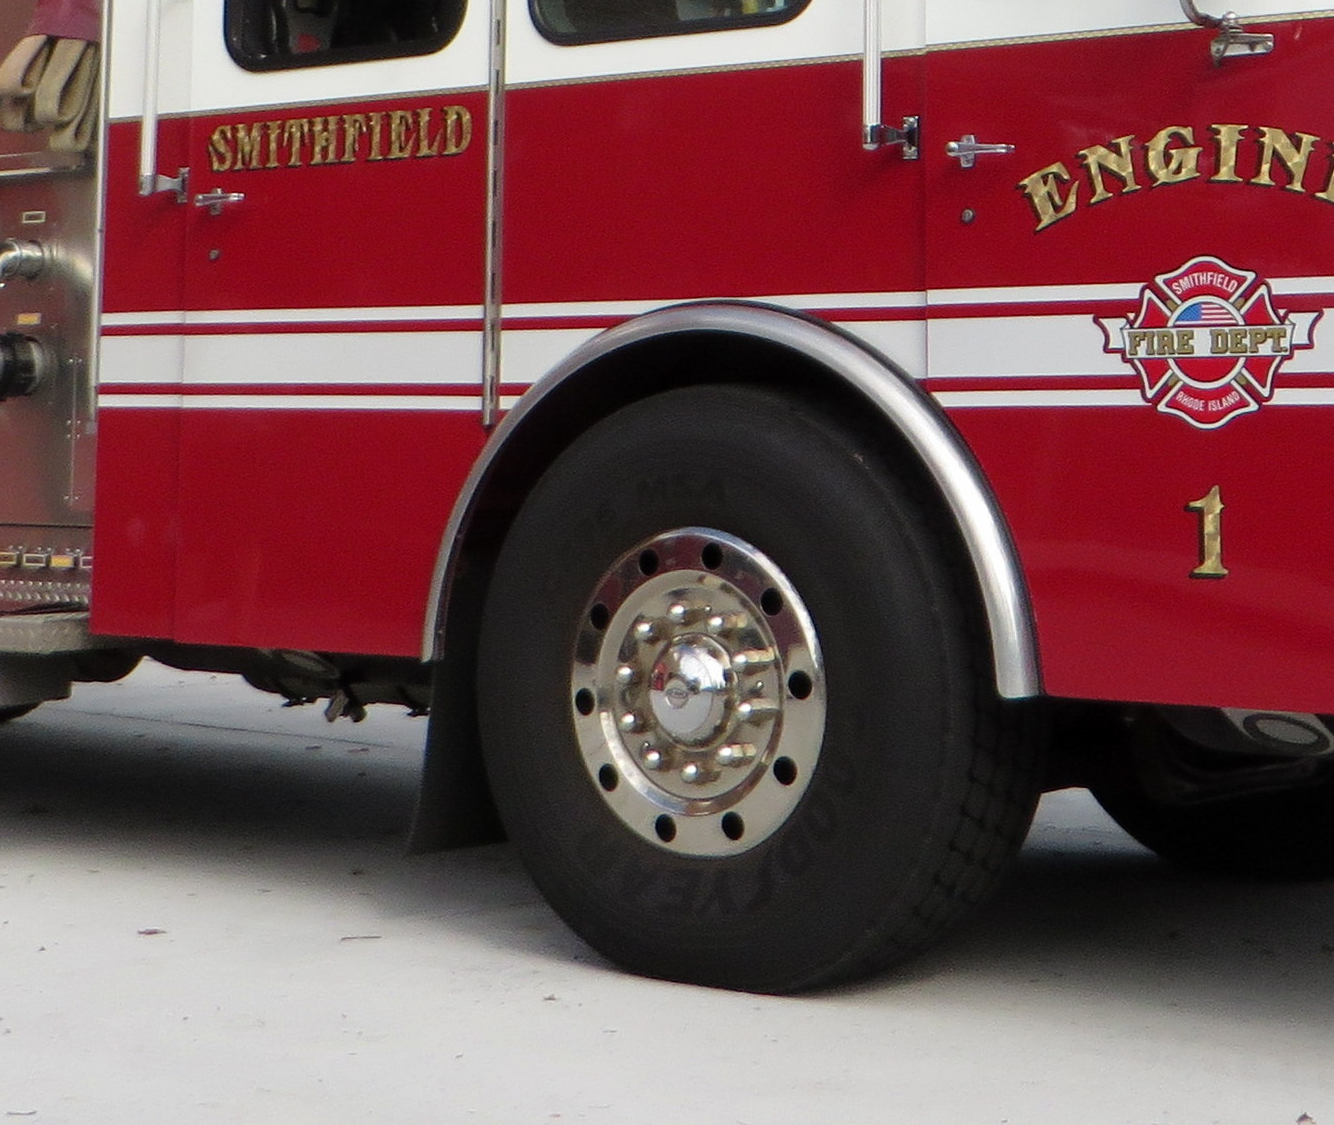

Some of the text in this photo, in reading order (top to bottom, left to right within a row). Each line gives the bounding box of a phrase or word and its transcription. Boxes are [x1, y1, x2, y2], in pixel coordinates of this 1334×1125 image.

[208, 105, 473, 173] SMITHFIELD
[1171, 271, 1240, 295] SMITHFIELD
[1127, 327, 1289, 355] FIRE DEPT.
[1174, 390, 1241, 412] RHODE ISLAND
[1185, 484, 1230, 578] 1
